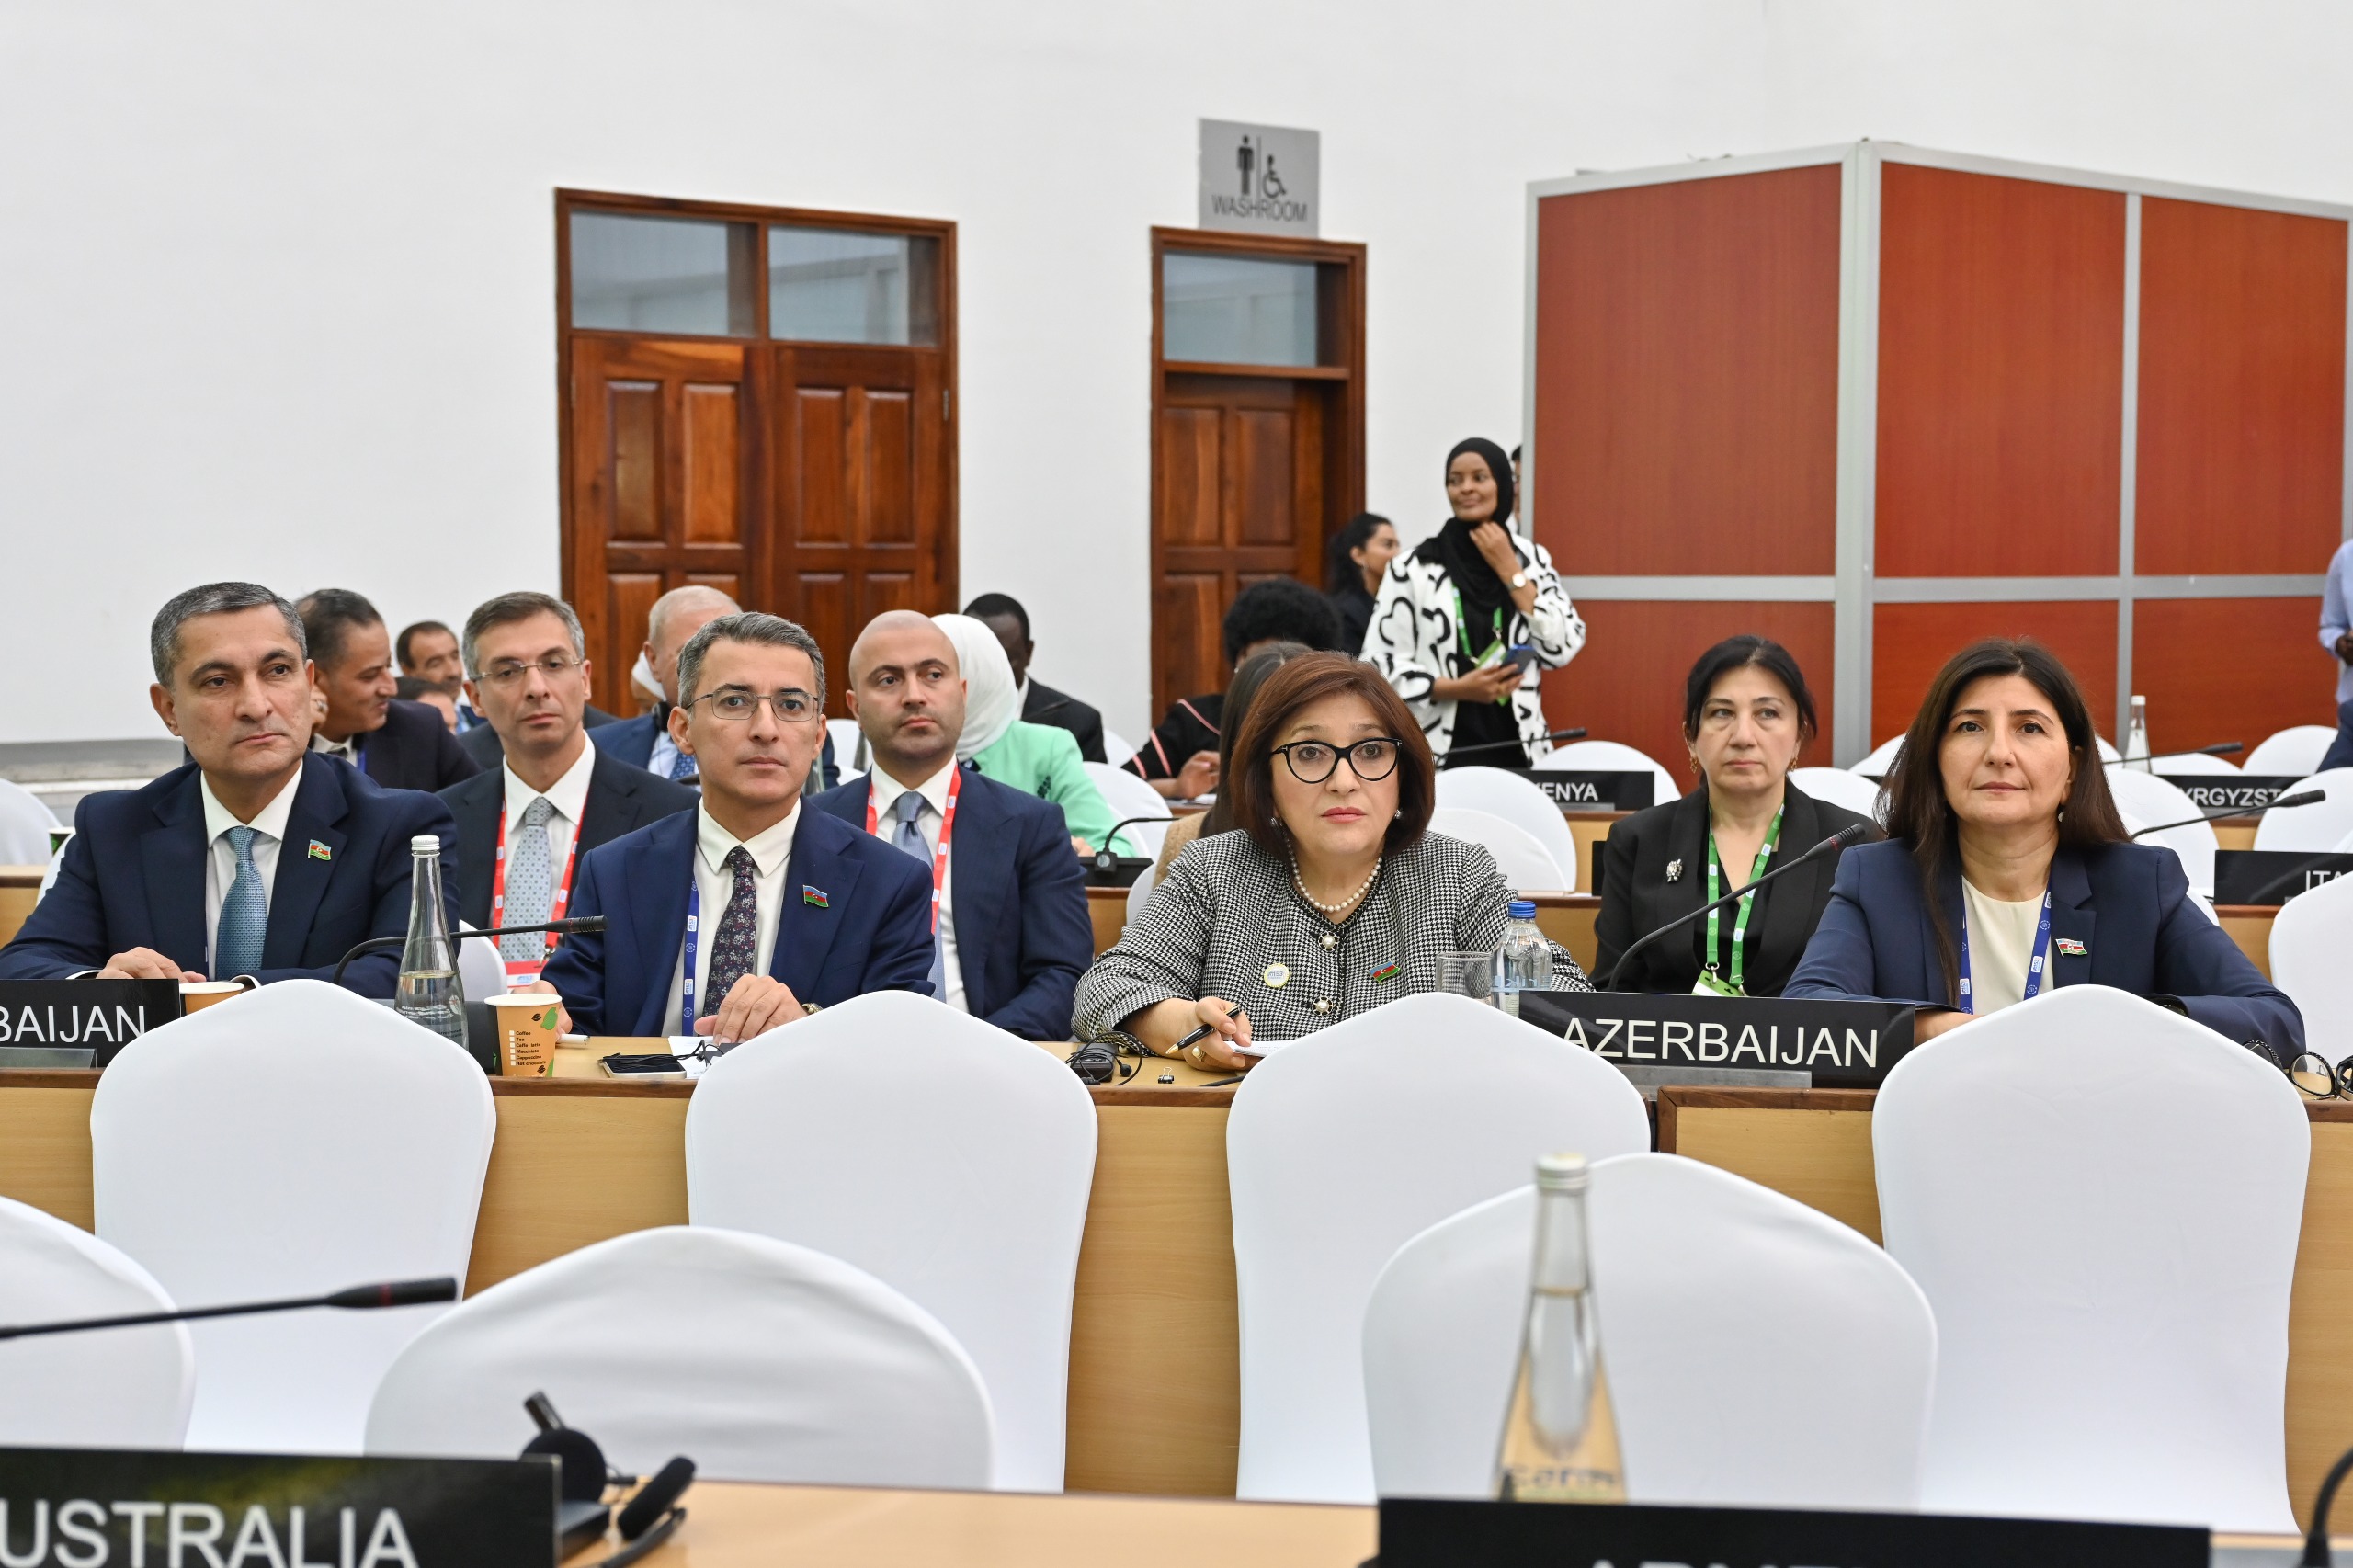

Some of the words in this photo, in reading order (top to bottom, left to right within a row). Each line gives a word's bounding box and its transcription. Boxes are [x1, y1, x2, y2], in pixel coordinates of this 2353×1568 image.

[1211, 194, 1308, 222] WASHROOM
[1536, 782, 1599, 801] ENYA
[2179, 787, 2282, 807] RGYZST
[1563, 1017, 1877, 1068] AZERBAIJAN
[0, 1499, 419, 1568] USTRALIA
